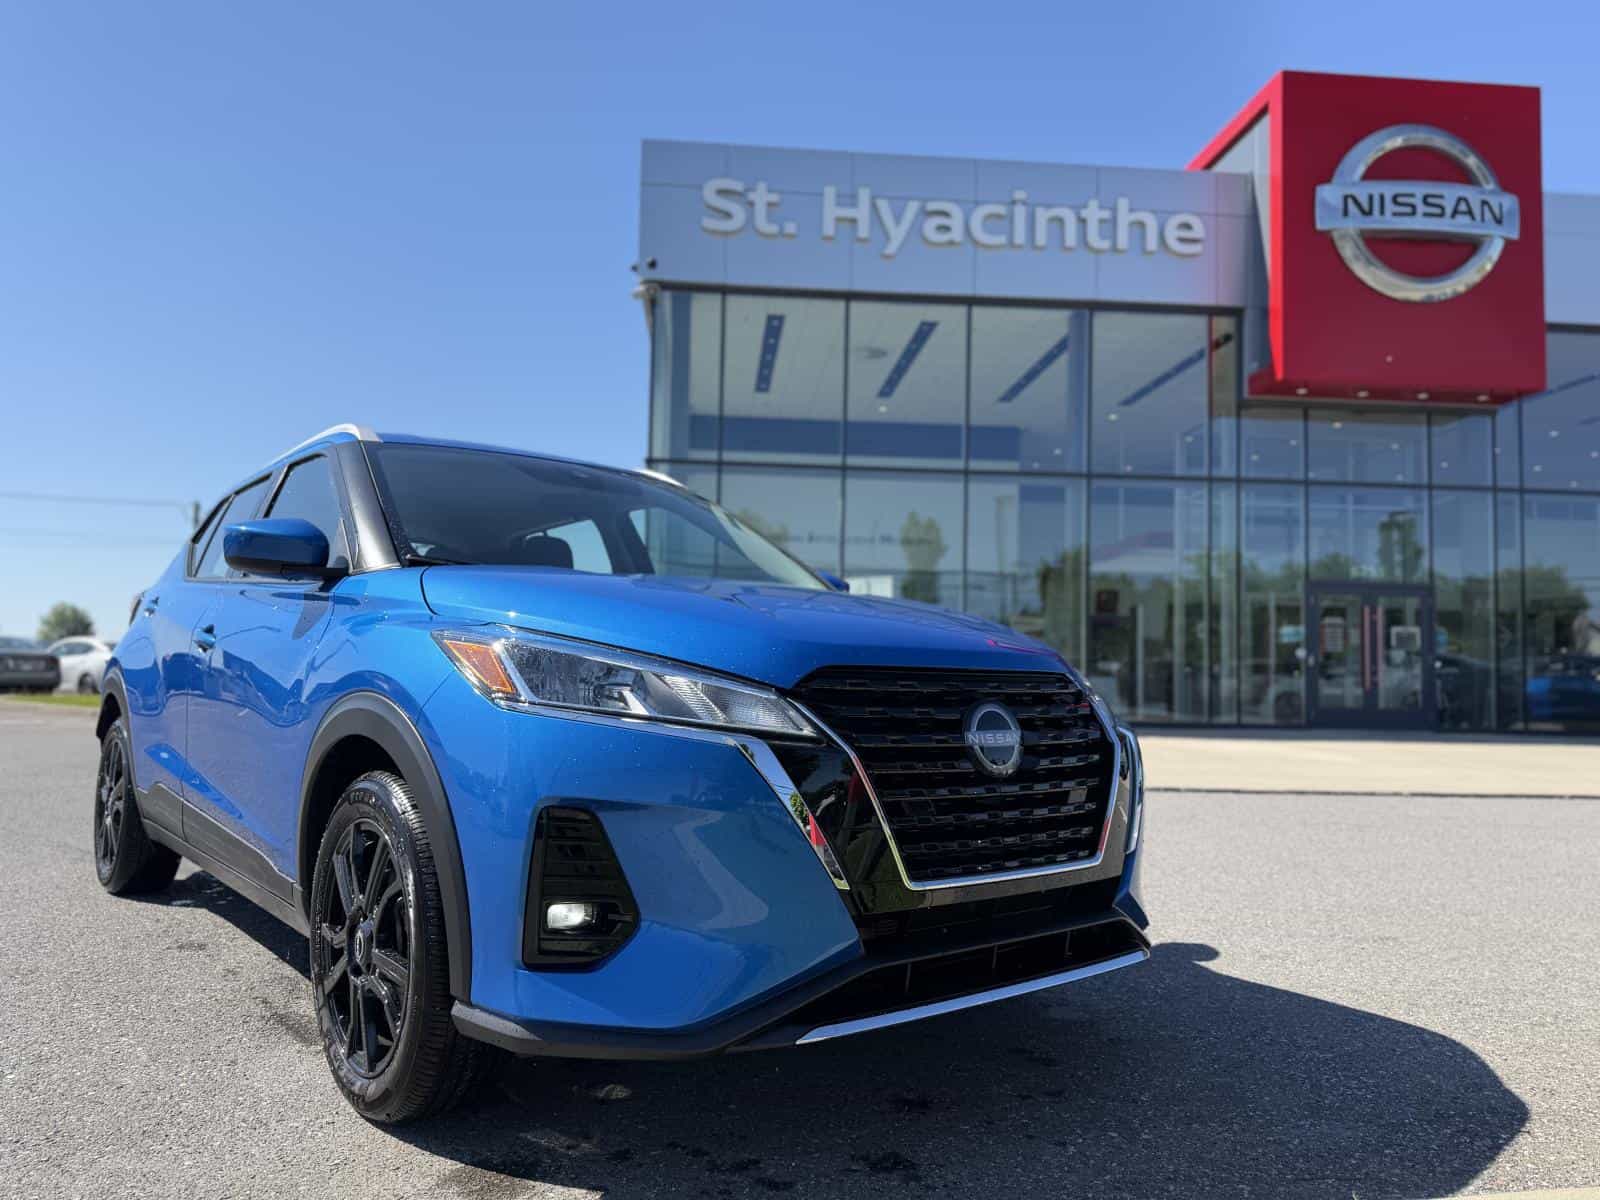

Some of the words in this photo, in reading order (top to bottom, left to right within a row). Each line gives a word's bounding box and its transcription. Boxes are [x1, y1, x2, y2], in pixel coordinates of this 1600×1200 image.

[702, 178, 798, 238] St.
[822, 185, 1205, 259] Hyacinthe
[1342, 192, 1504, 225] NISSAN
